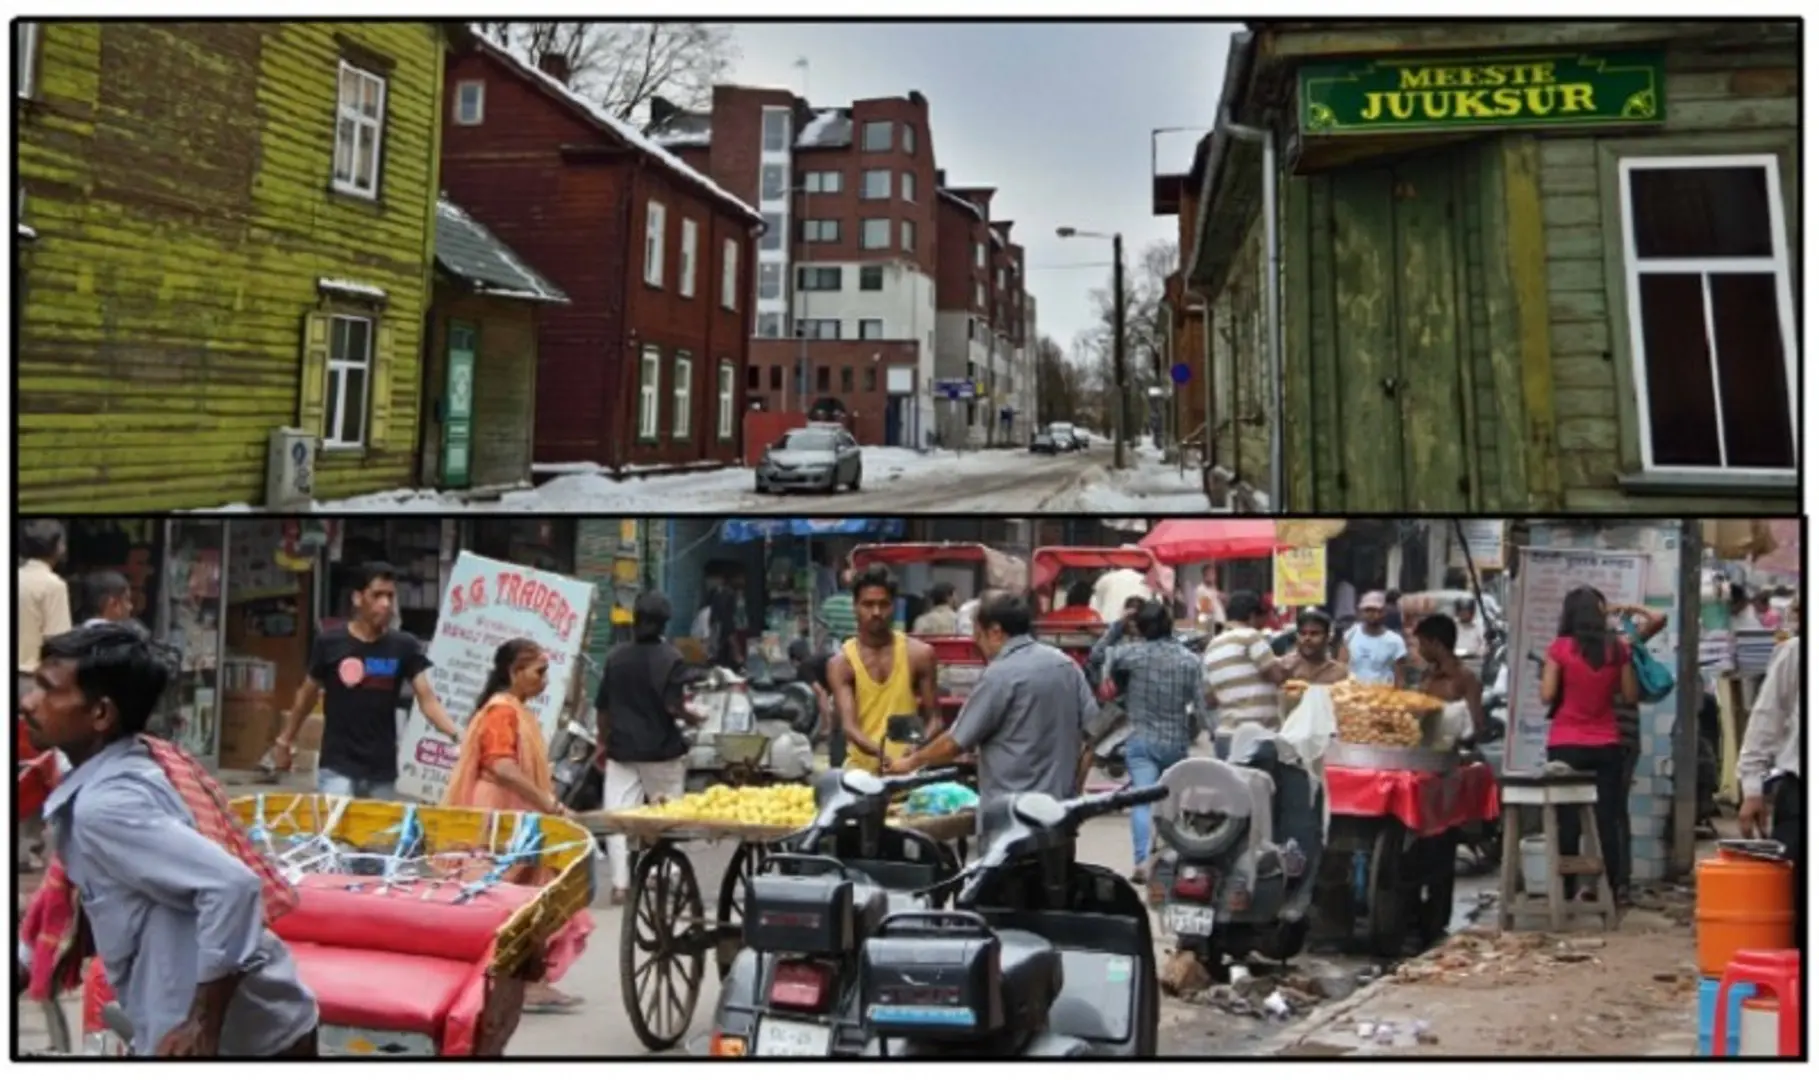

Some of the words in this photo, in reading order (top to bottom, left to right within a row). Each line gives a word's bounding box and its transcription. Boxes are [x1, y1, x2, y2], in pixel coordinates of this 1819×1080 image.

[1401, 63, 1555, 88] MEESTE
[1362, 83, 1596, 119] JUUKSUR
[496, 571, 577, 642] TRADERS
